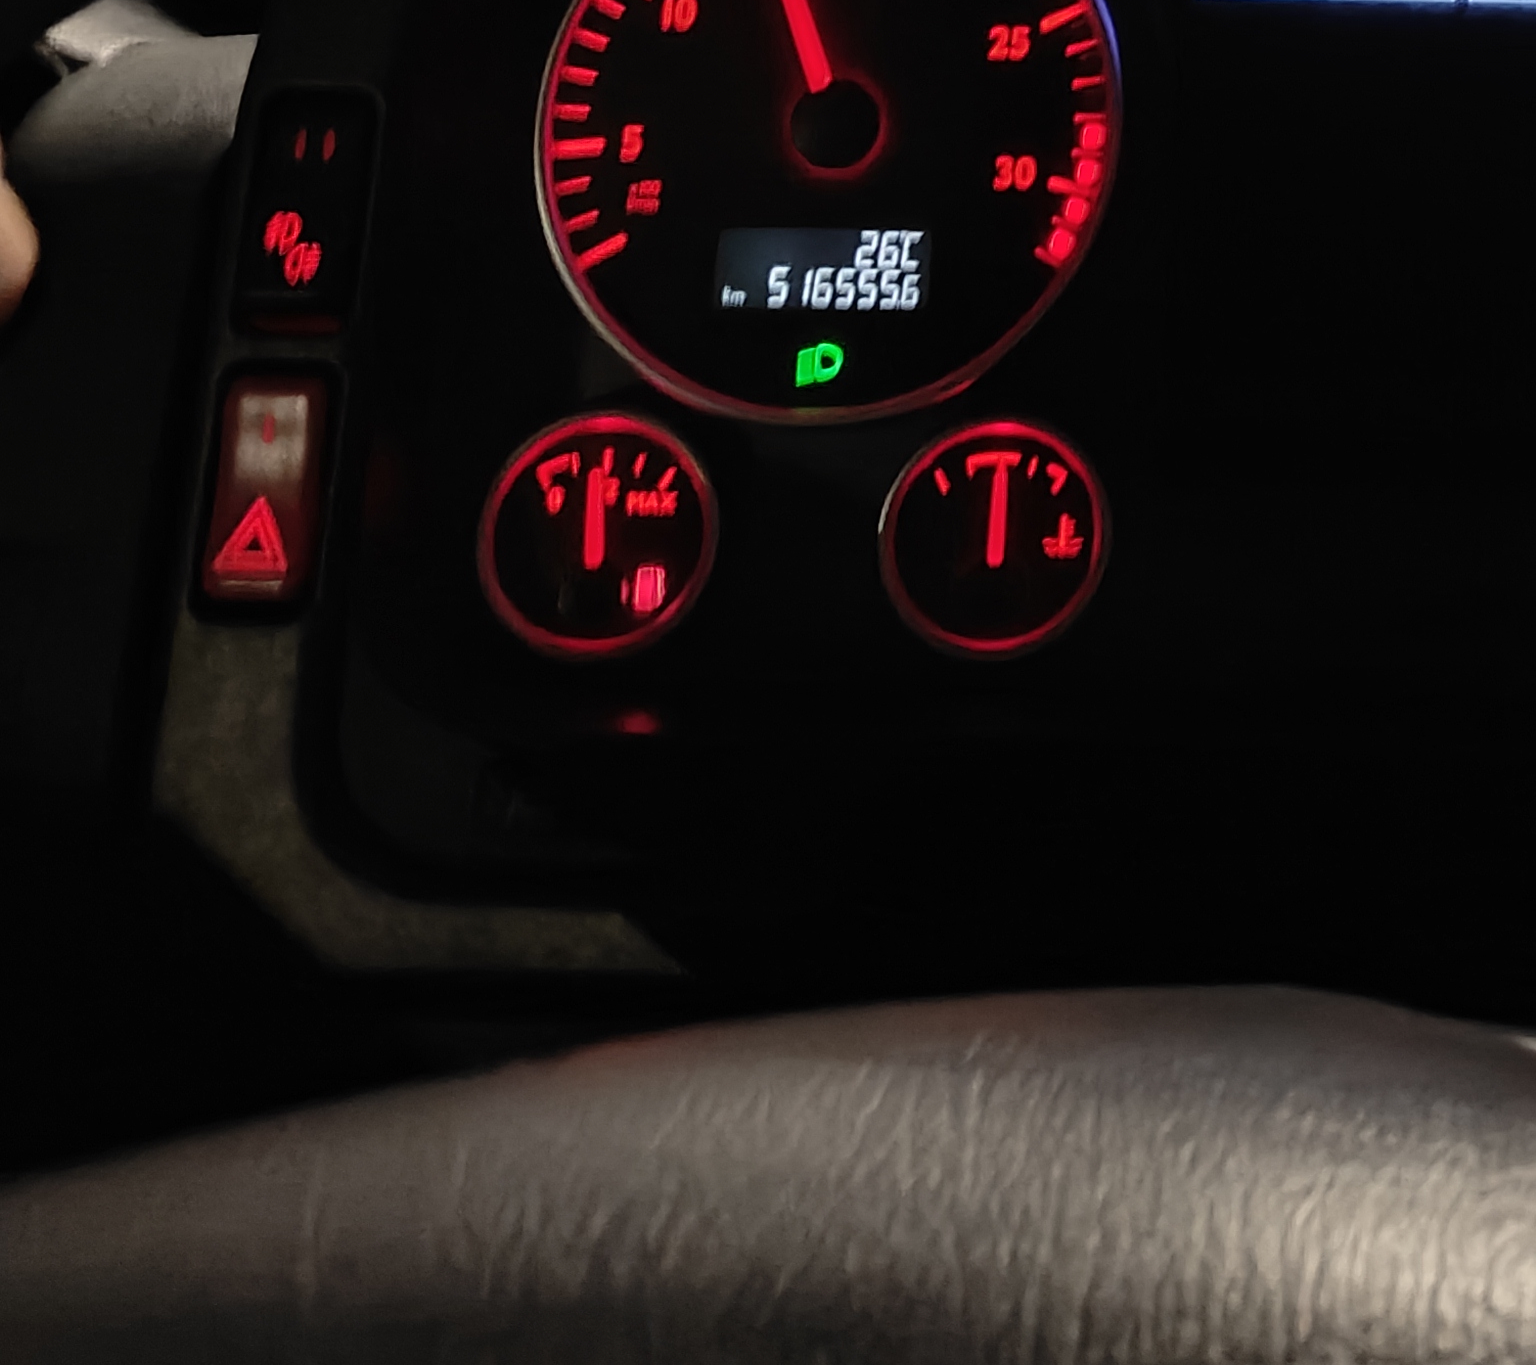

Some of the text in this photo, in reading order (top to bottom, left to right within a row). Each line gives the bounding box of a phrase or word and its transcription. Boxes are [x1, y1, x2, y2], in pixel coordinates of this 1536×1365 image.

[988, 25, 1030, 60] 25
[620, 125, 644, 162] 5
[993, 155, 1037, 190] 30
[722, 286, 746, 305] km
[626, 491, 679, 517] MAX
